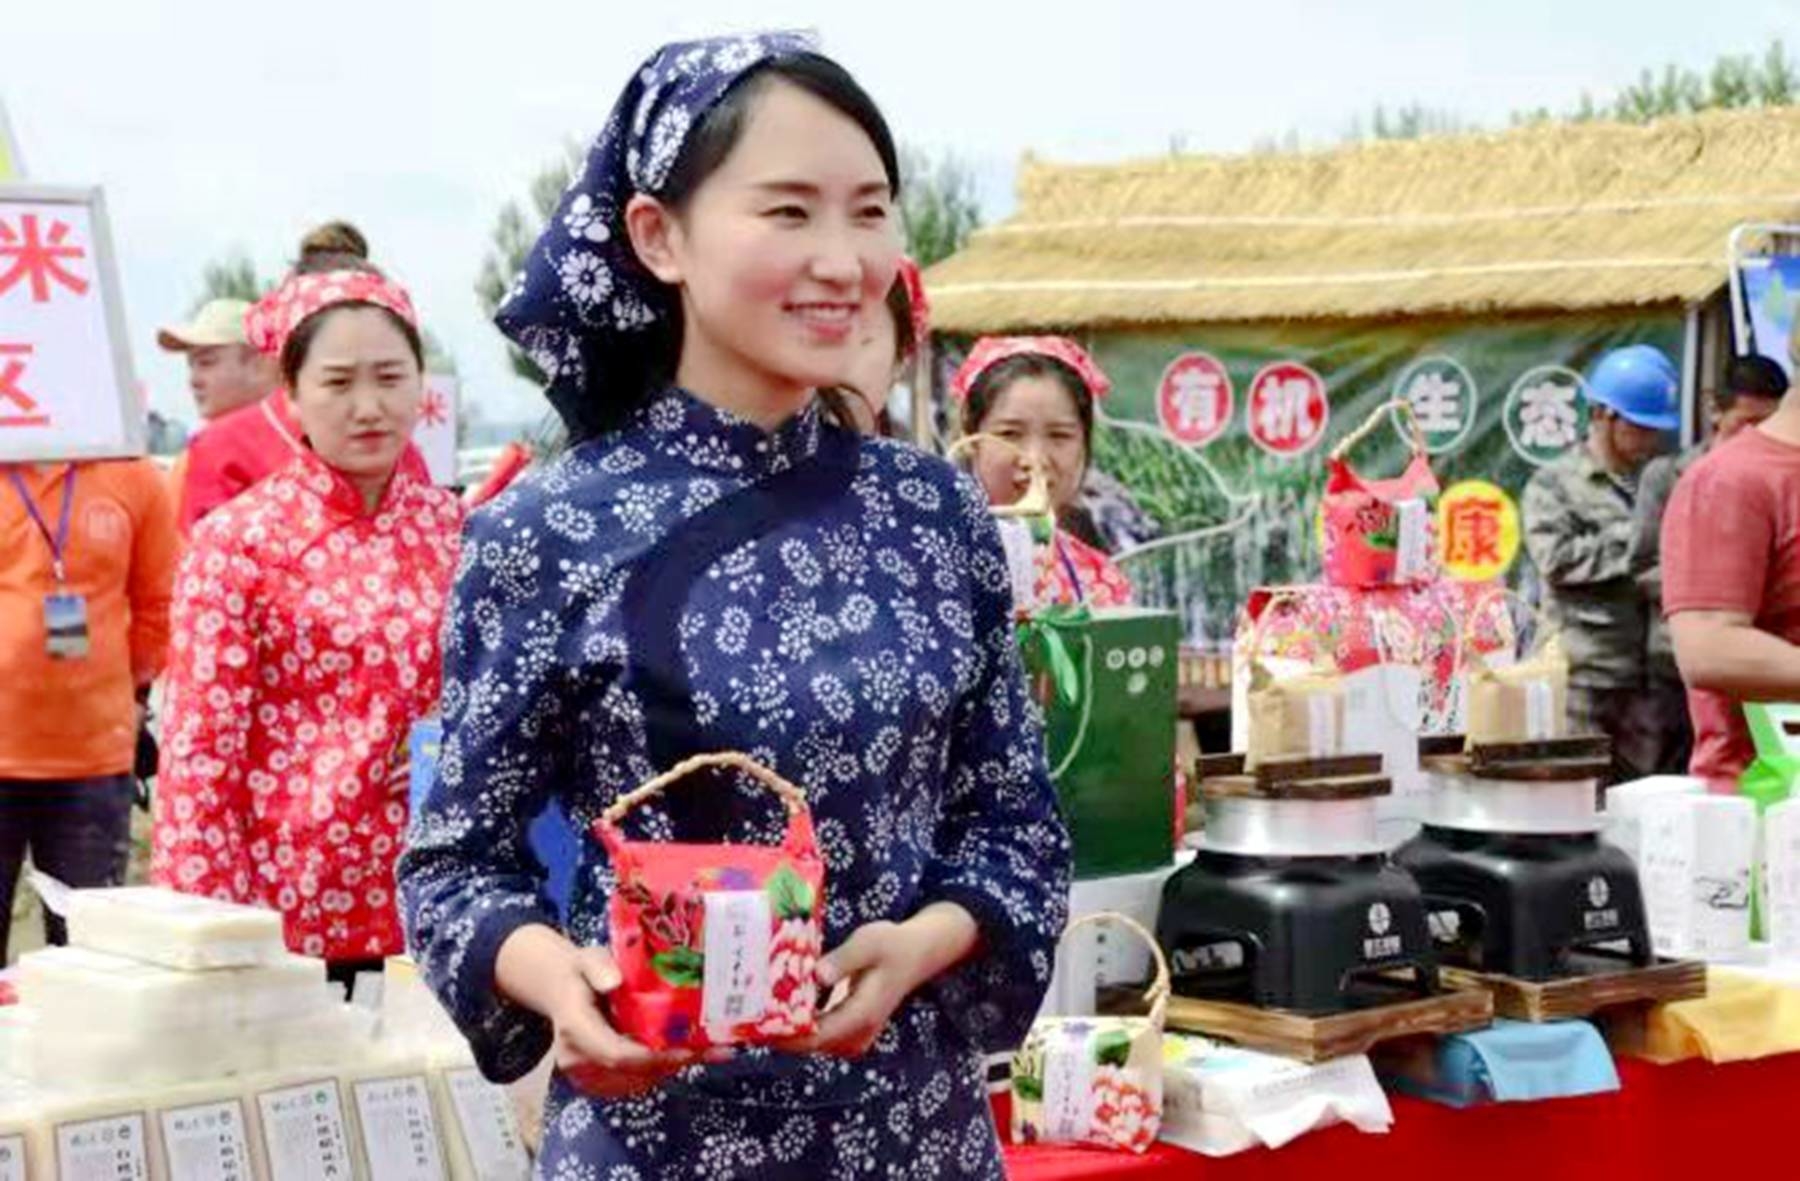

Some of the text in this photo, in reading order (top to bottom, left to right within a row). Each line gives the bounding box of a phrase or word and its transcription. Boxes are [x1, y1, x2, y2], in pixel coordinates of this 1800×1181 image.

[0, 214, 88, 302] 米
[1170, 367, 1578, 447] 有机 生态
[1445, 497, 1500, 564] 康
